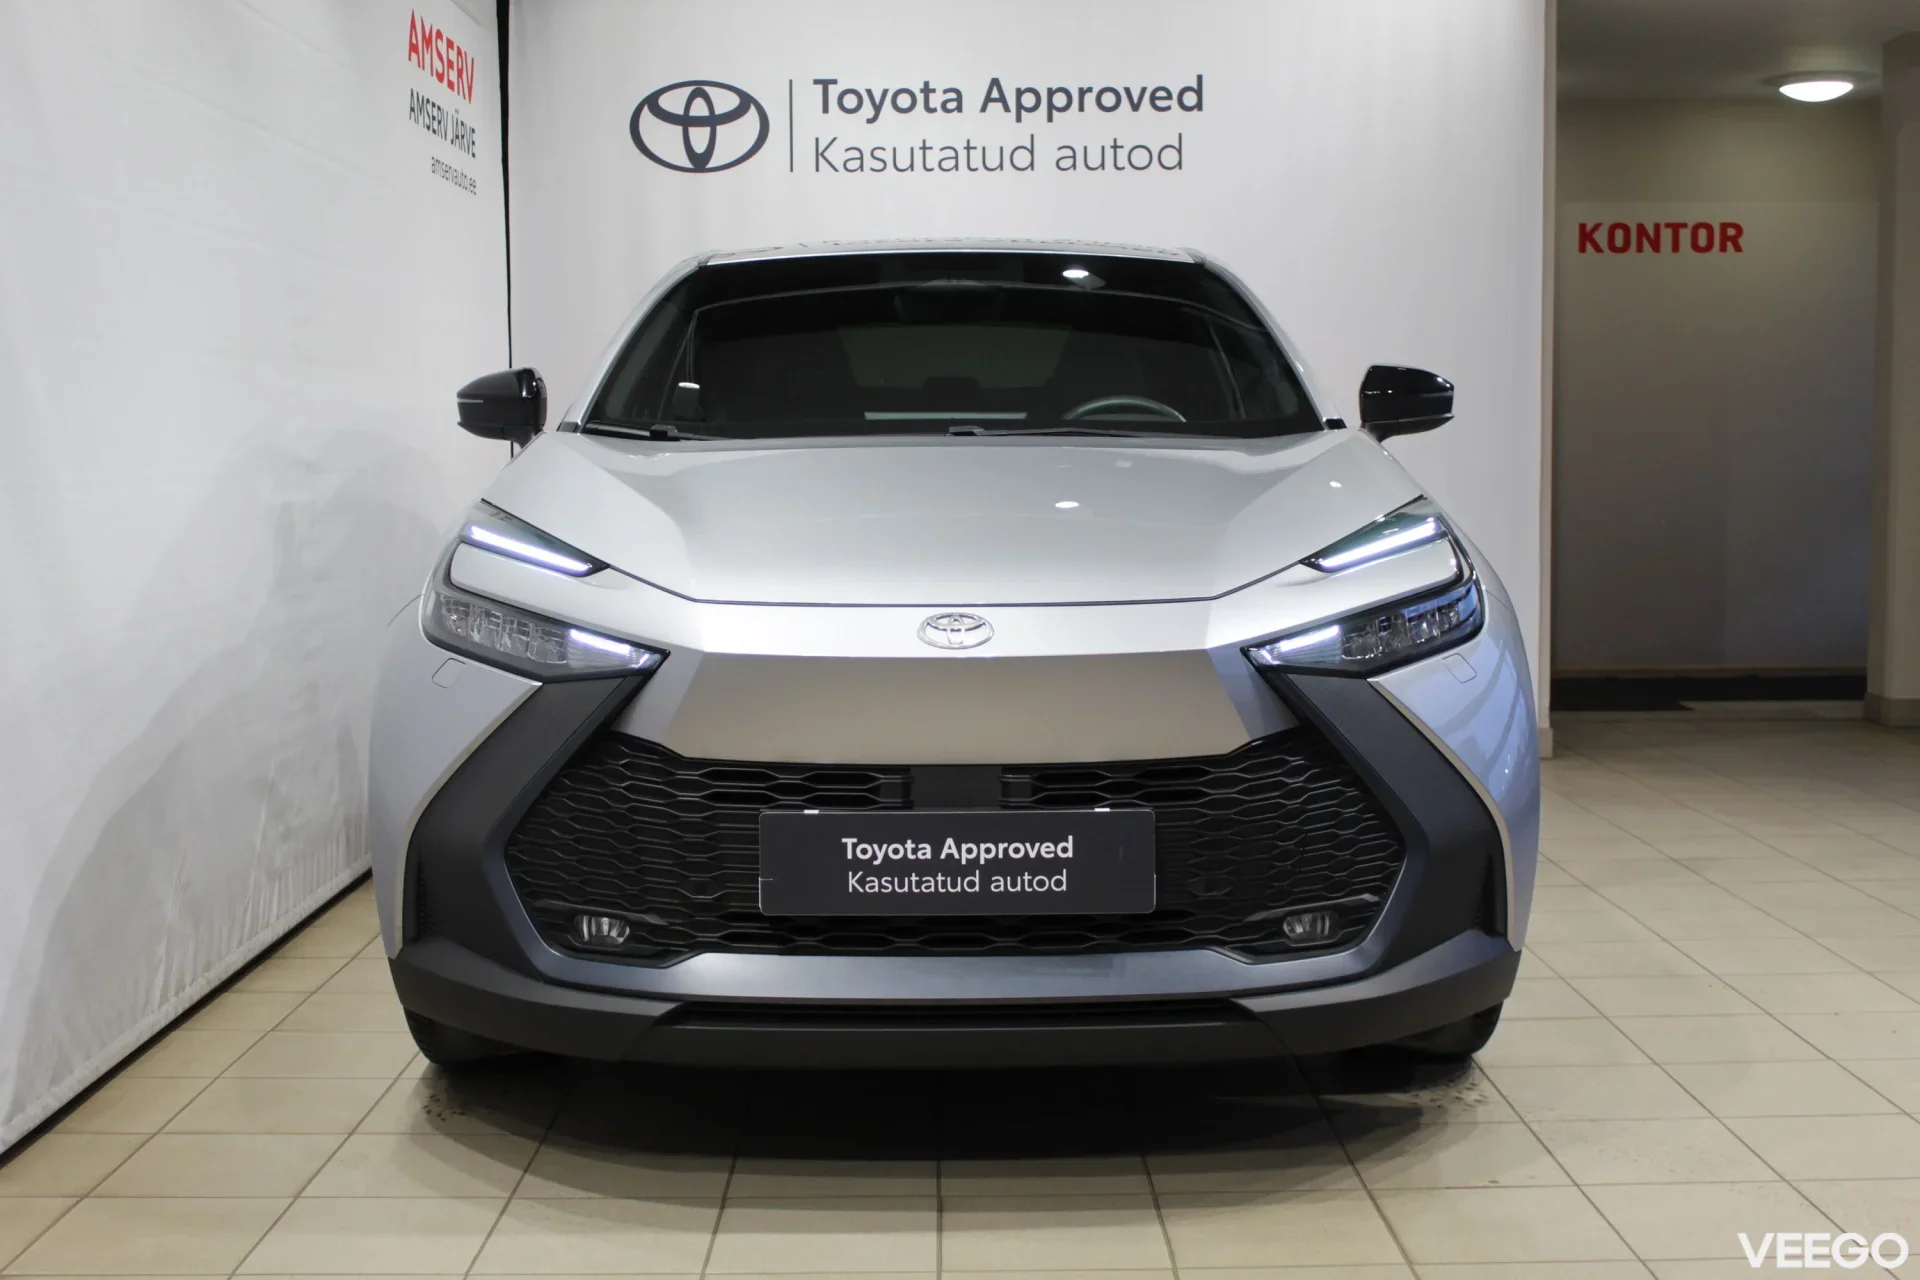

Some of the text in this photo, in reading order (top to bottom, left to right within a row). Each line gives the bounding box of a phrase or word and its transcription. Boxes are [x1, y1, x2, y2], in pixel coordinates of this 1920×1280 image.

[408, 9, 475, 104] AMSERV
[813, 74, 1204, 123] Toyota Approved
[409, 88, 476, 158] AMSERV JÄRVE
[815, 132, 1183, 173] Kasutatud autod
[431, 156, 477, 196] amservauto.ee
[1578, 222, 1744, 254] KONTOR
[842, 835, 1074, 865] Toyota Approved
[848, 869, 1067, 893] Kasutatud autod
